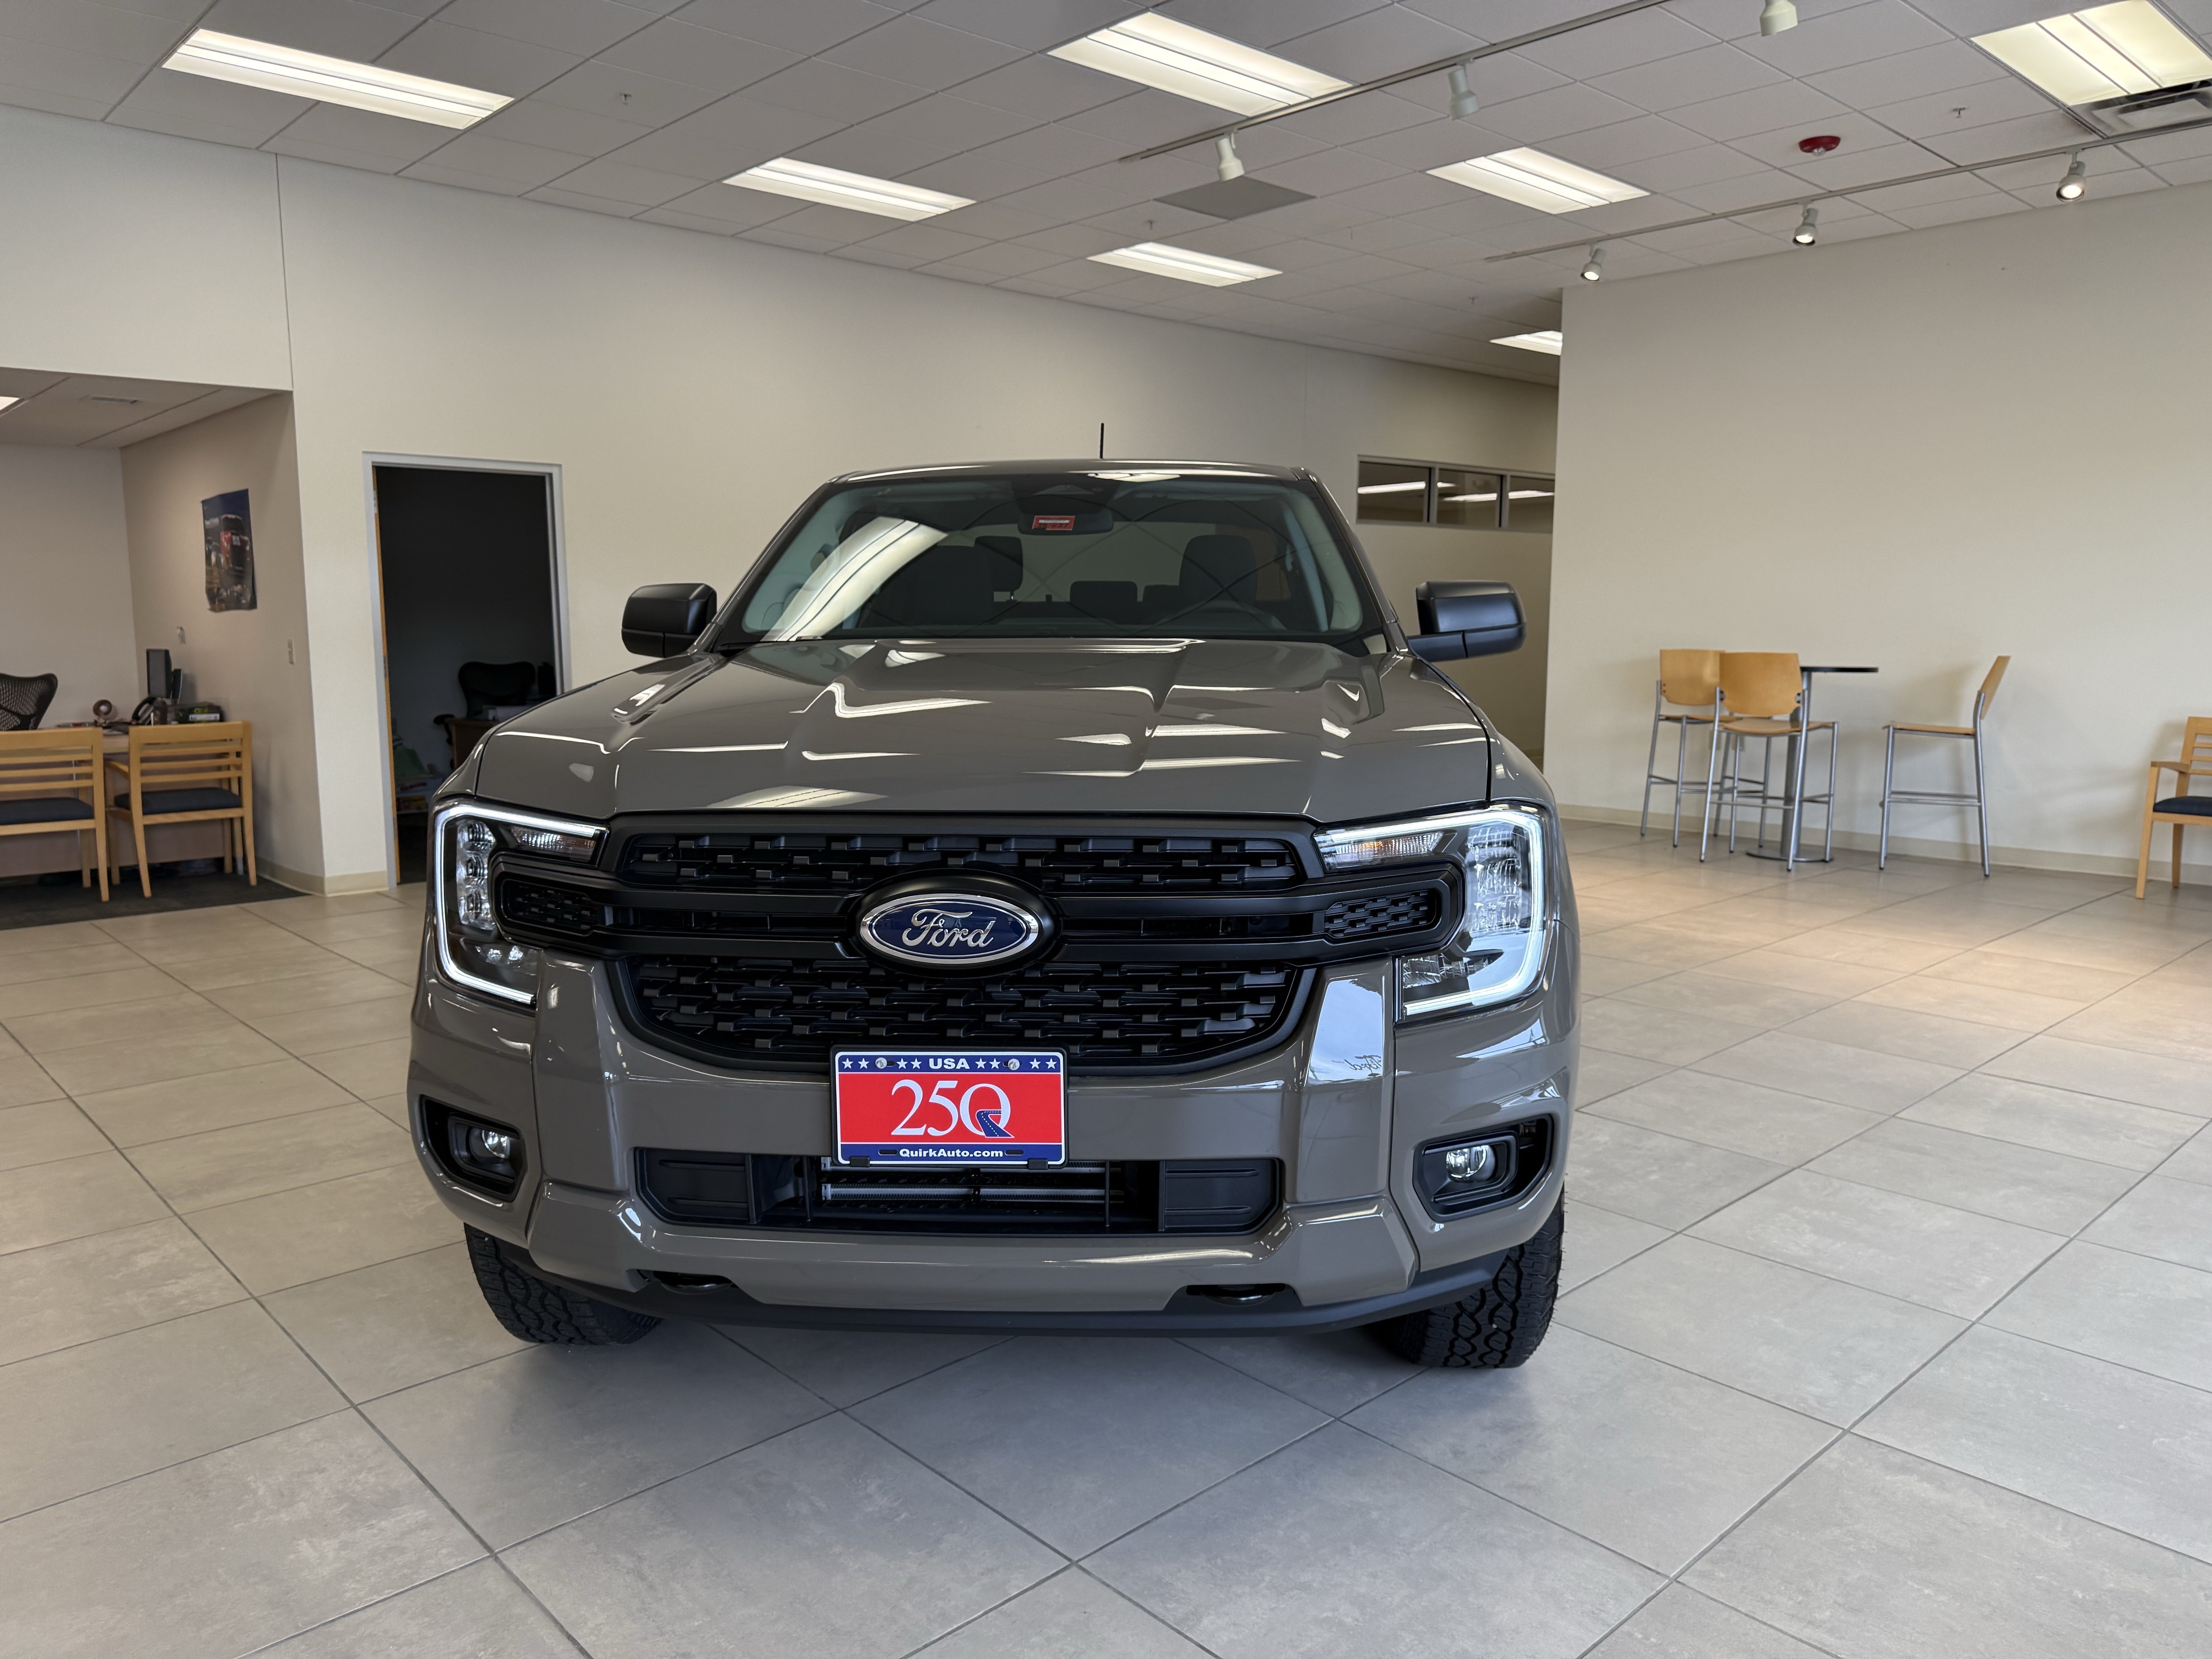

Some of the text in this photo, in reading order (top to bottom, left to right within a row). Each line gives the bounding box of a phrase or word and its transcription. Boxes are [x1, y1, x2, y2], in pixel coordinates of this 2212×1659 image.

[902, 909, 997, 947] Ford
[929, 1058, 970, 1069] USA
[899, 1148, 1003, 1158] QuirkAuto.com
